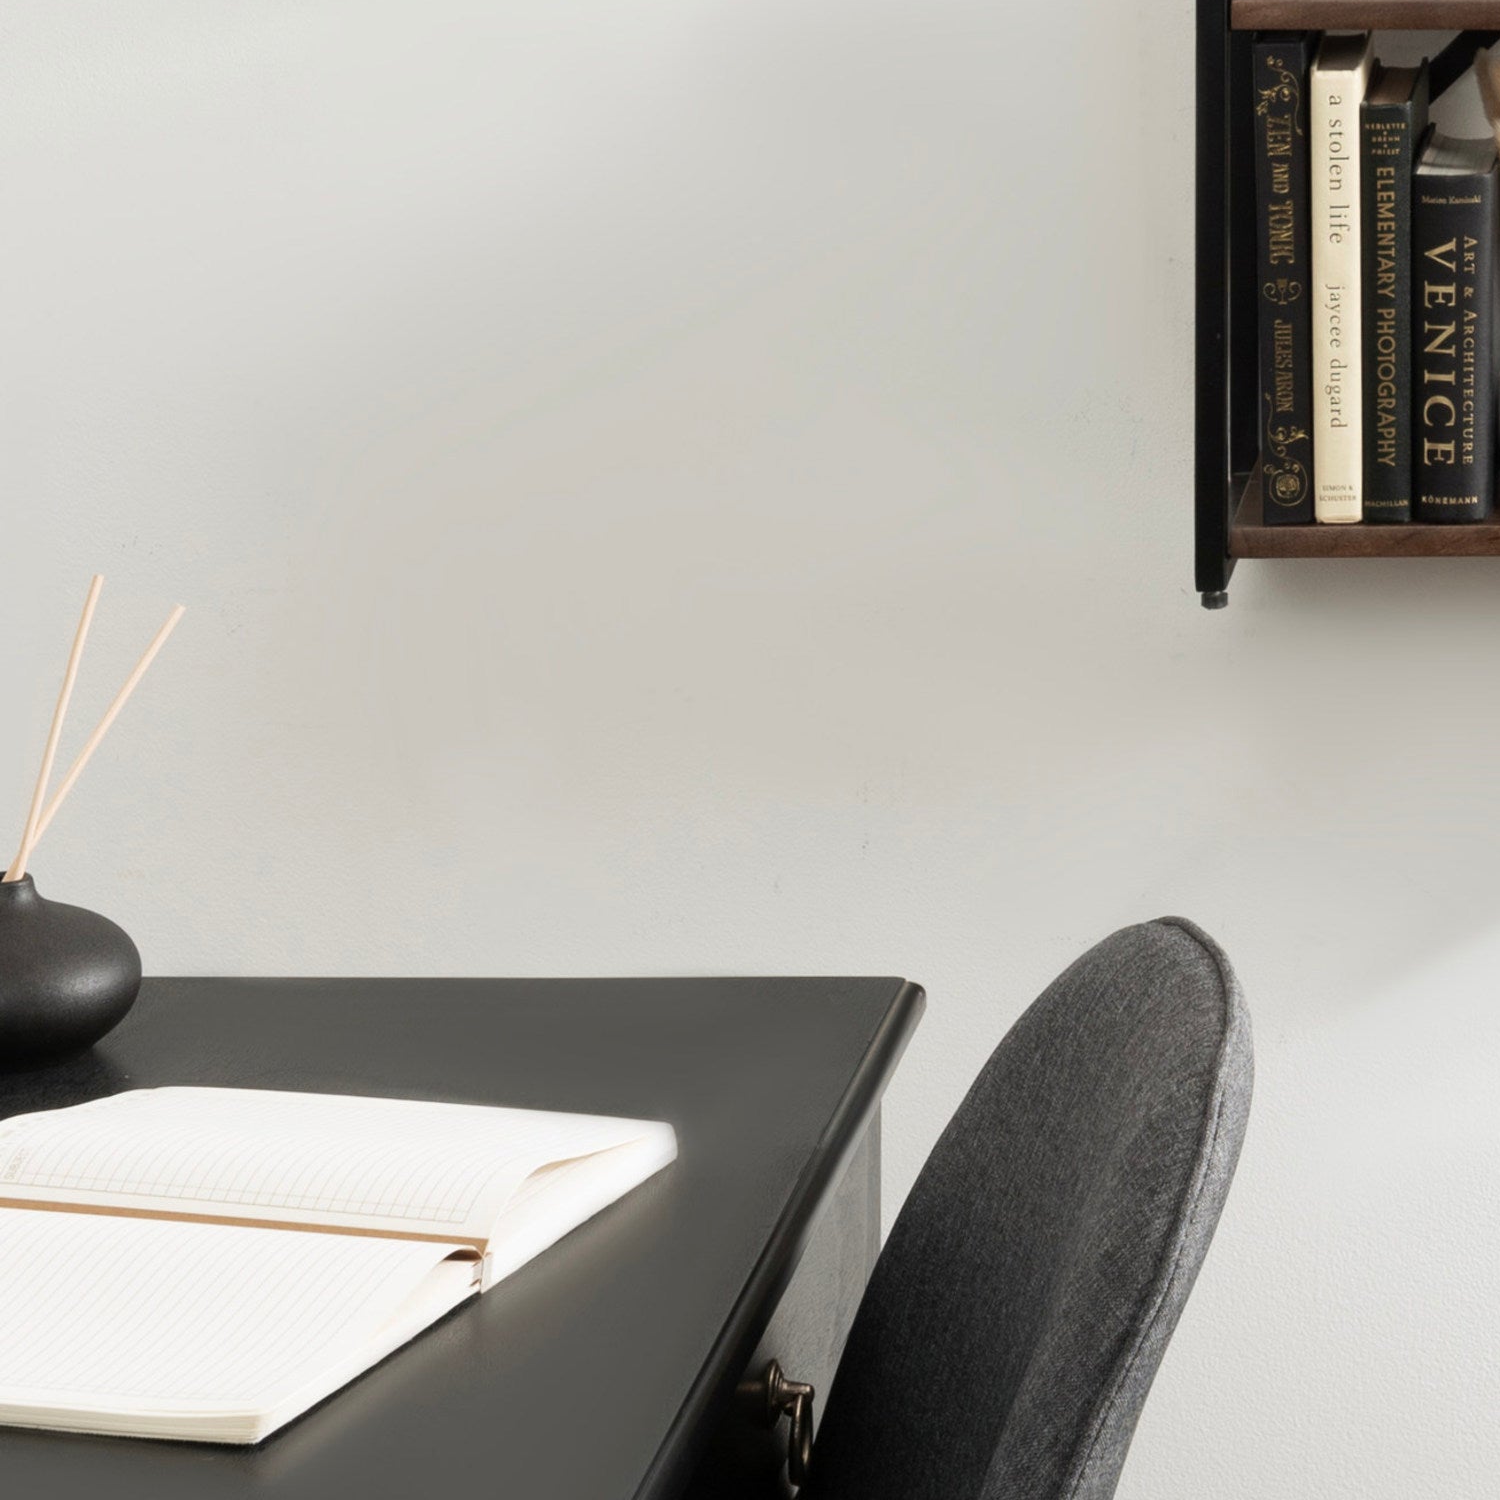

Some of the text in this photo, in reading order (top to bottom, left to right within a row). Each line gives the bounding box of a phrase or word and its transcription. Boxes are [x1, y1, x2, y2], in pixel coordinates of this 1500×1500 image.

[1266, 114, 1295, 265] ZEN AND TONIC
[1328, 94, 1351, 244] a stolen life
[1274, 319, 1294, 412] JULES ARON
[1325, 284, 1348, 428] jaycee dugard
[1376, 166, 1396, 467] ELEMENTARY PHOTOGRAPHY
[1423, 237, 1456, 467] VENICE
[1462, 236, 1478, 466] ART & ARCHITECTURE
